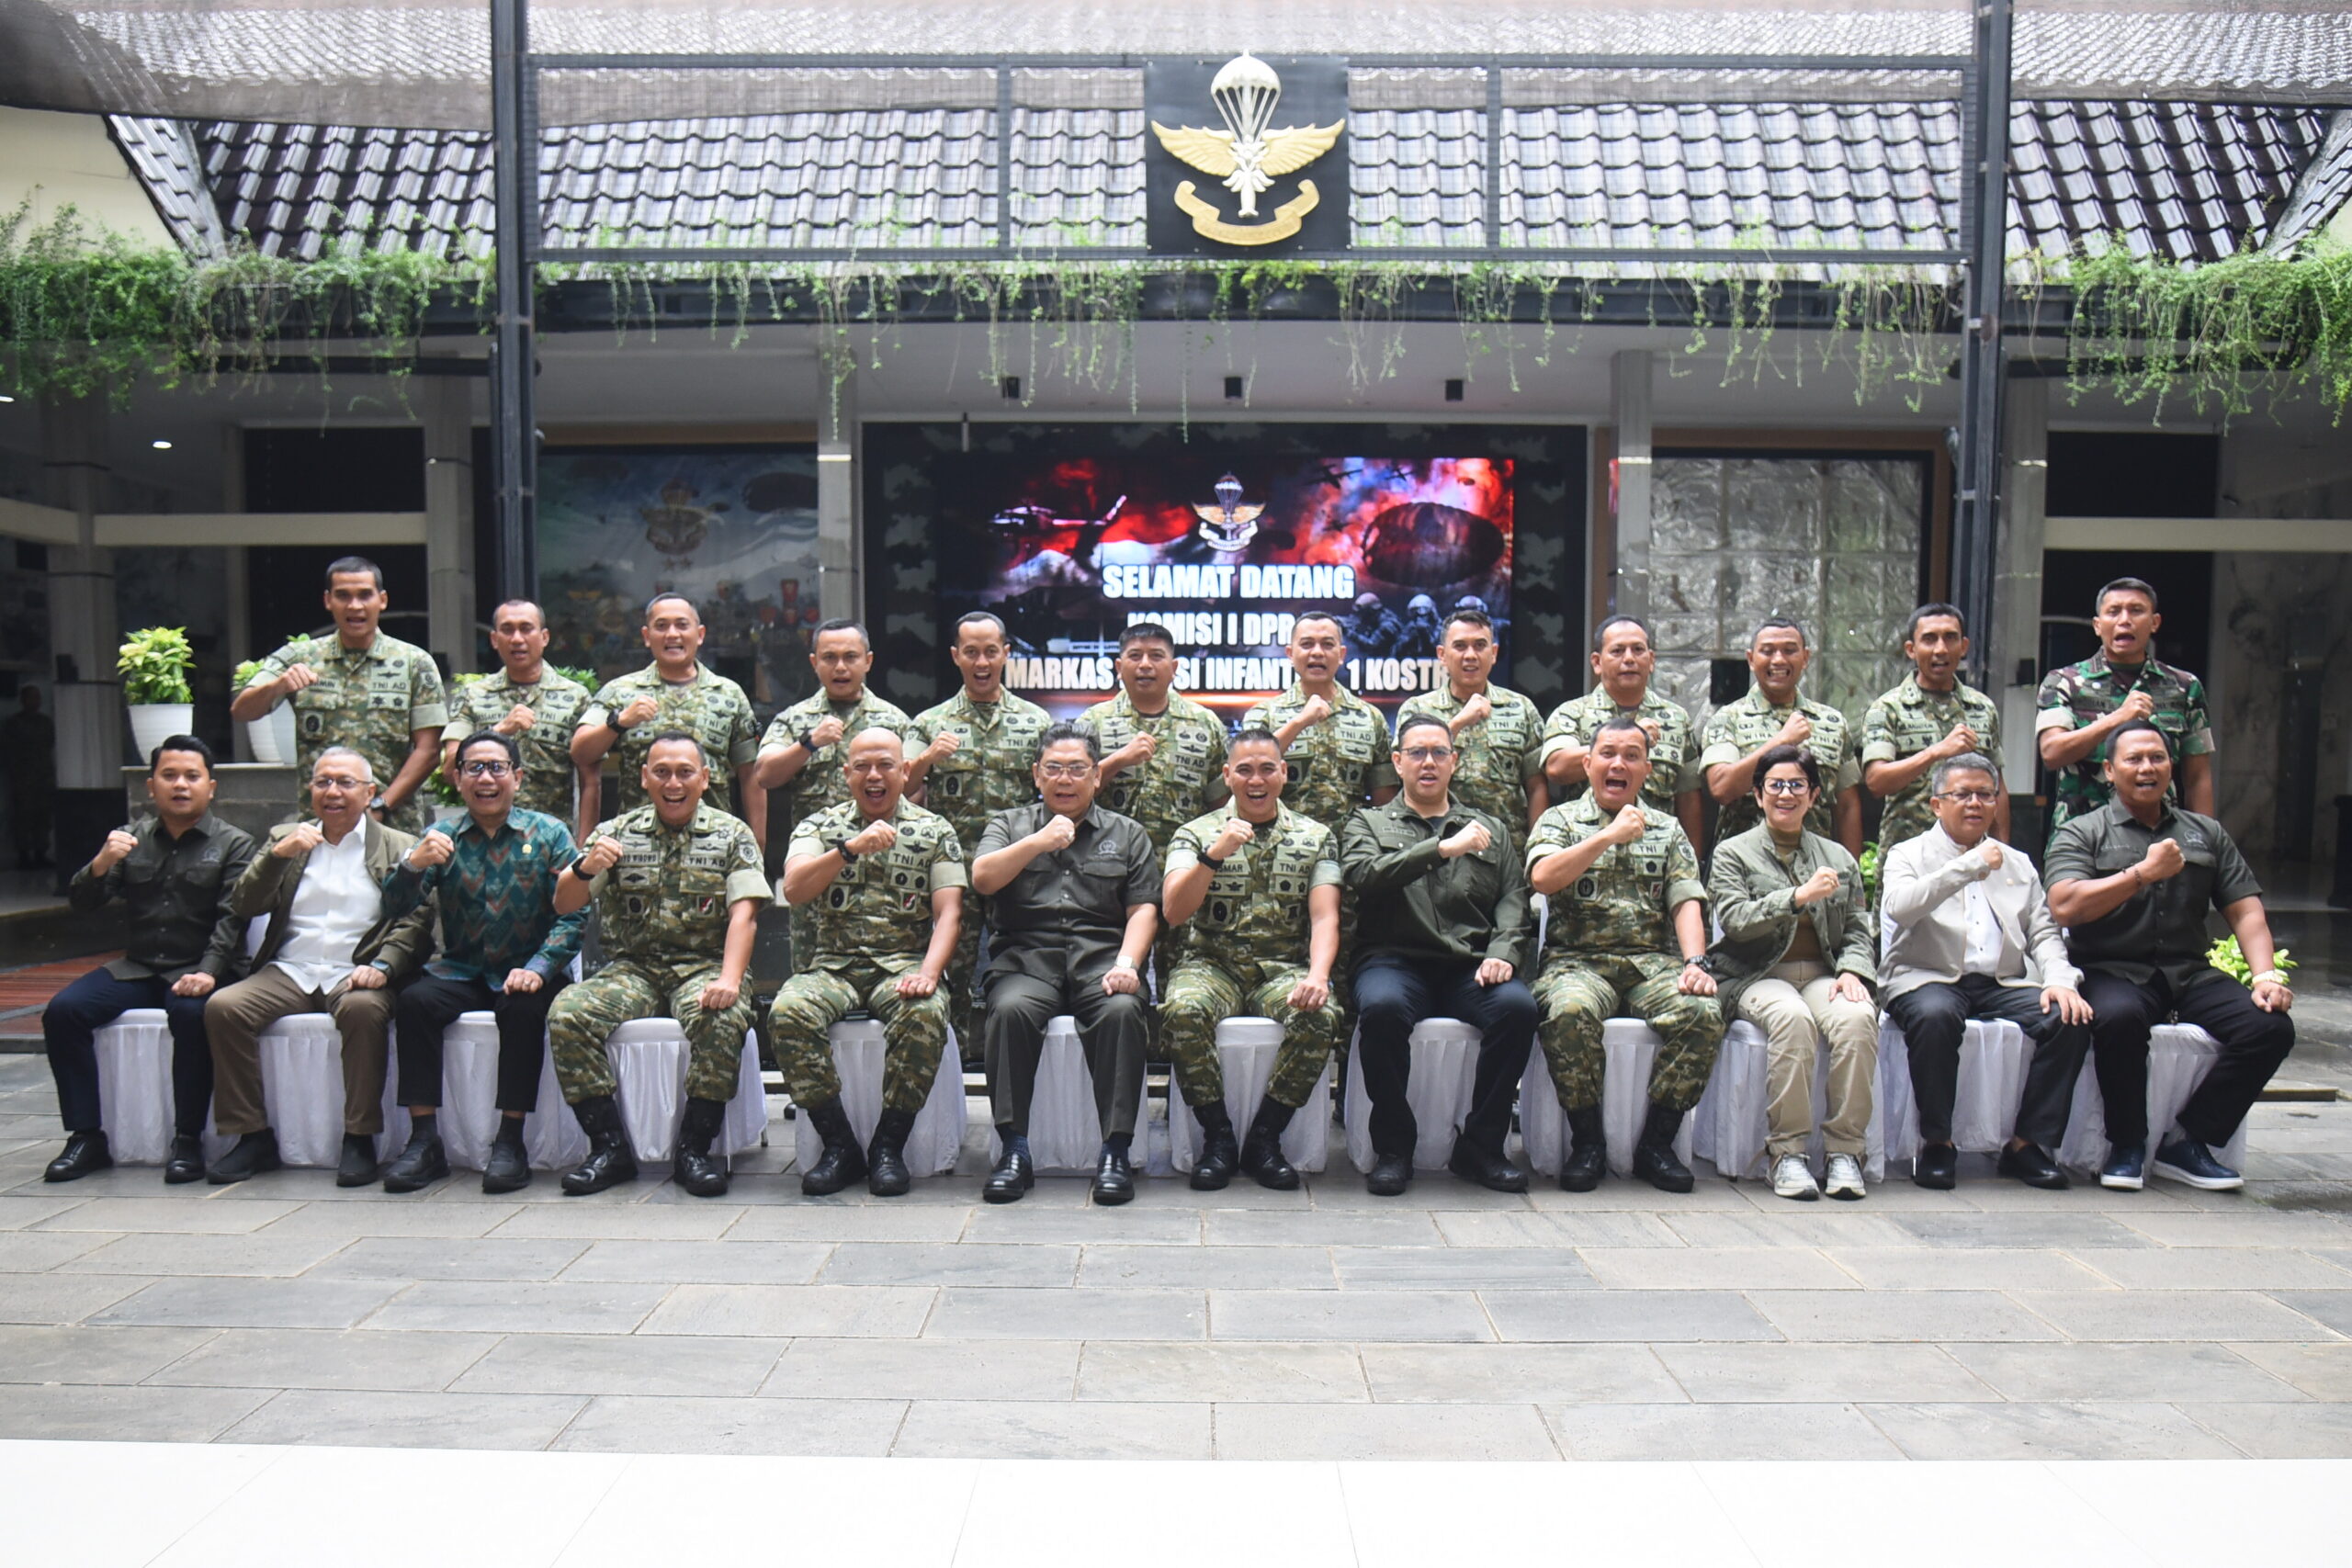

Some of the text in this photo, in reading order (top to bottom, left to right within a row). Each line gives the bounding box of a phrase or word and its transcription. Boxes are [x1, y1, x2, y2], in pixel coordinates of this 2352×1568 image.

[1102, 564, 1355, 598] SELAMAT DATANG
[1227, 613, 1238, 645] I
[1005, 657, 1114, 690] MARKAS
[1346, 658, 1360, 691] 1
[1365, 657, 1449, 691] KOSTR
[540, 711, 556, 720] TNI
[703, 717, 719, 729] TNI
[1340, 730, 1356, 739] TNI
[1668, 734, 1682, 745] AD
[1007, 739, 1023, 748] TNI
[1175, 754, 1191, 766] TNI
[1639, 845, 1657, 853] TNI
[690, 856, 707, 865] TNI
[894, 852, 913, 866] TNI
[1280, 863, 1296, 872] TNI
